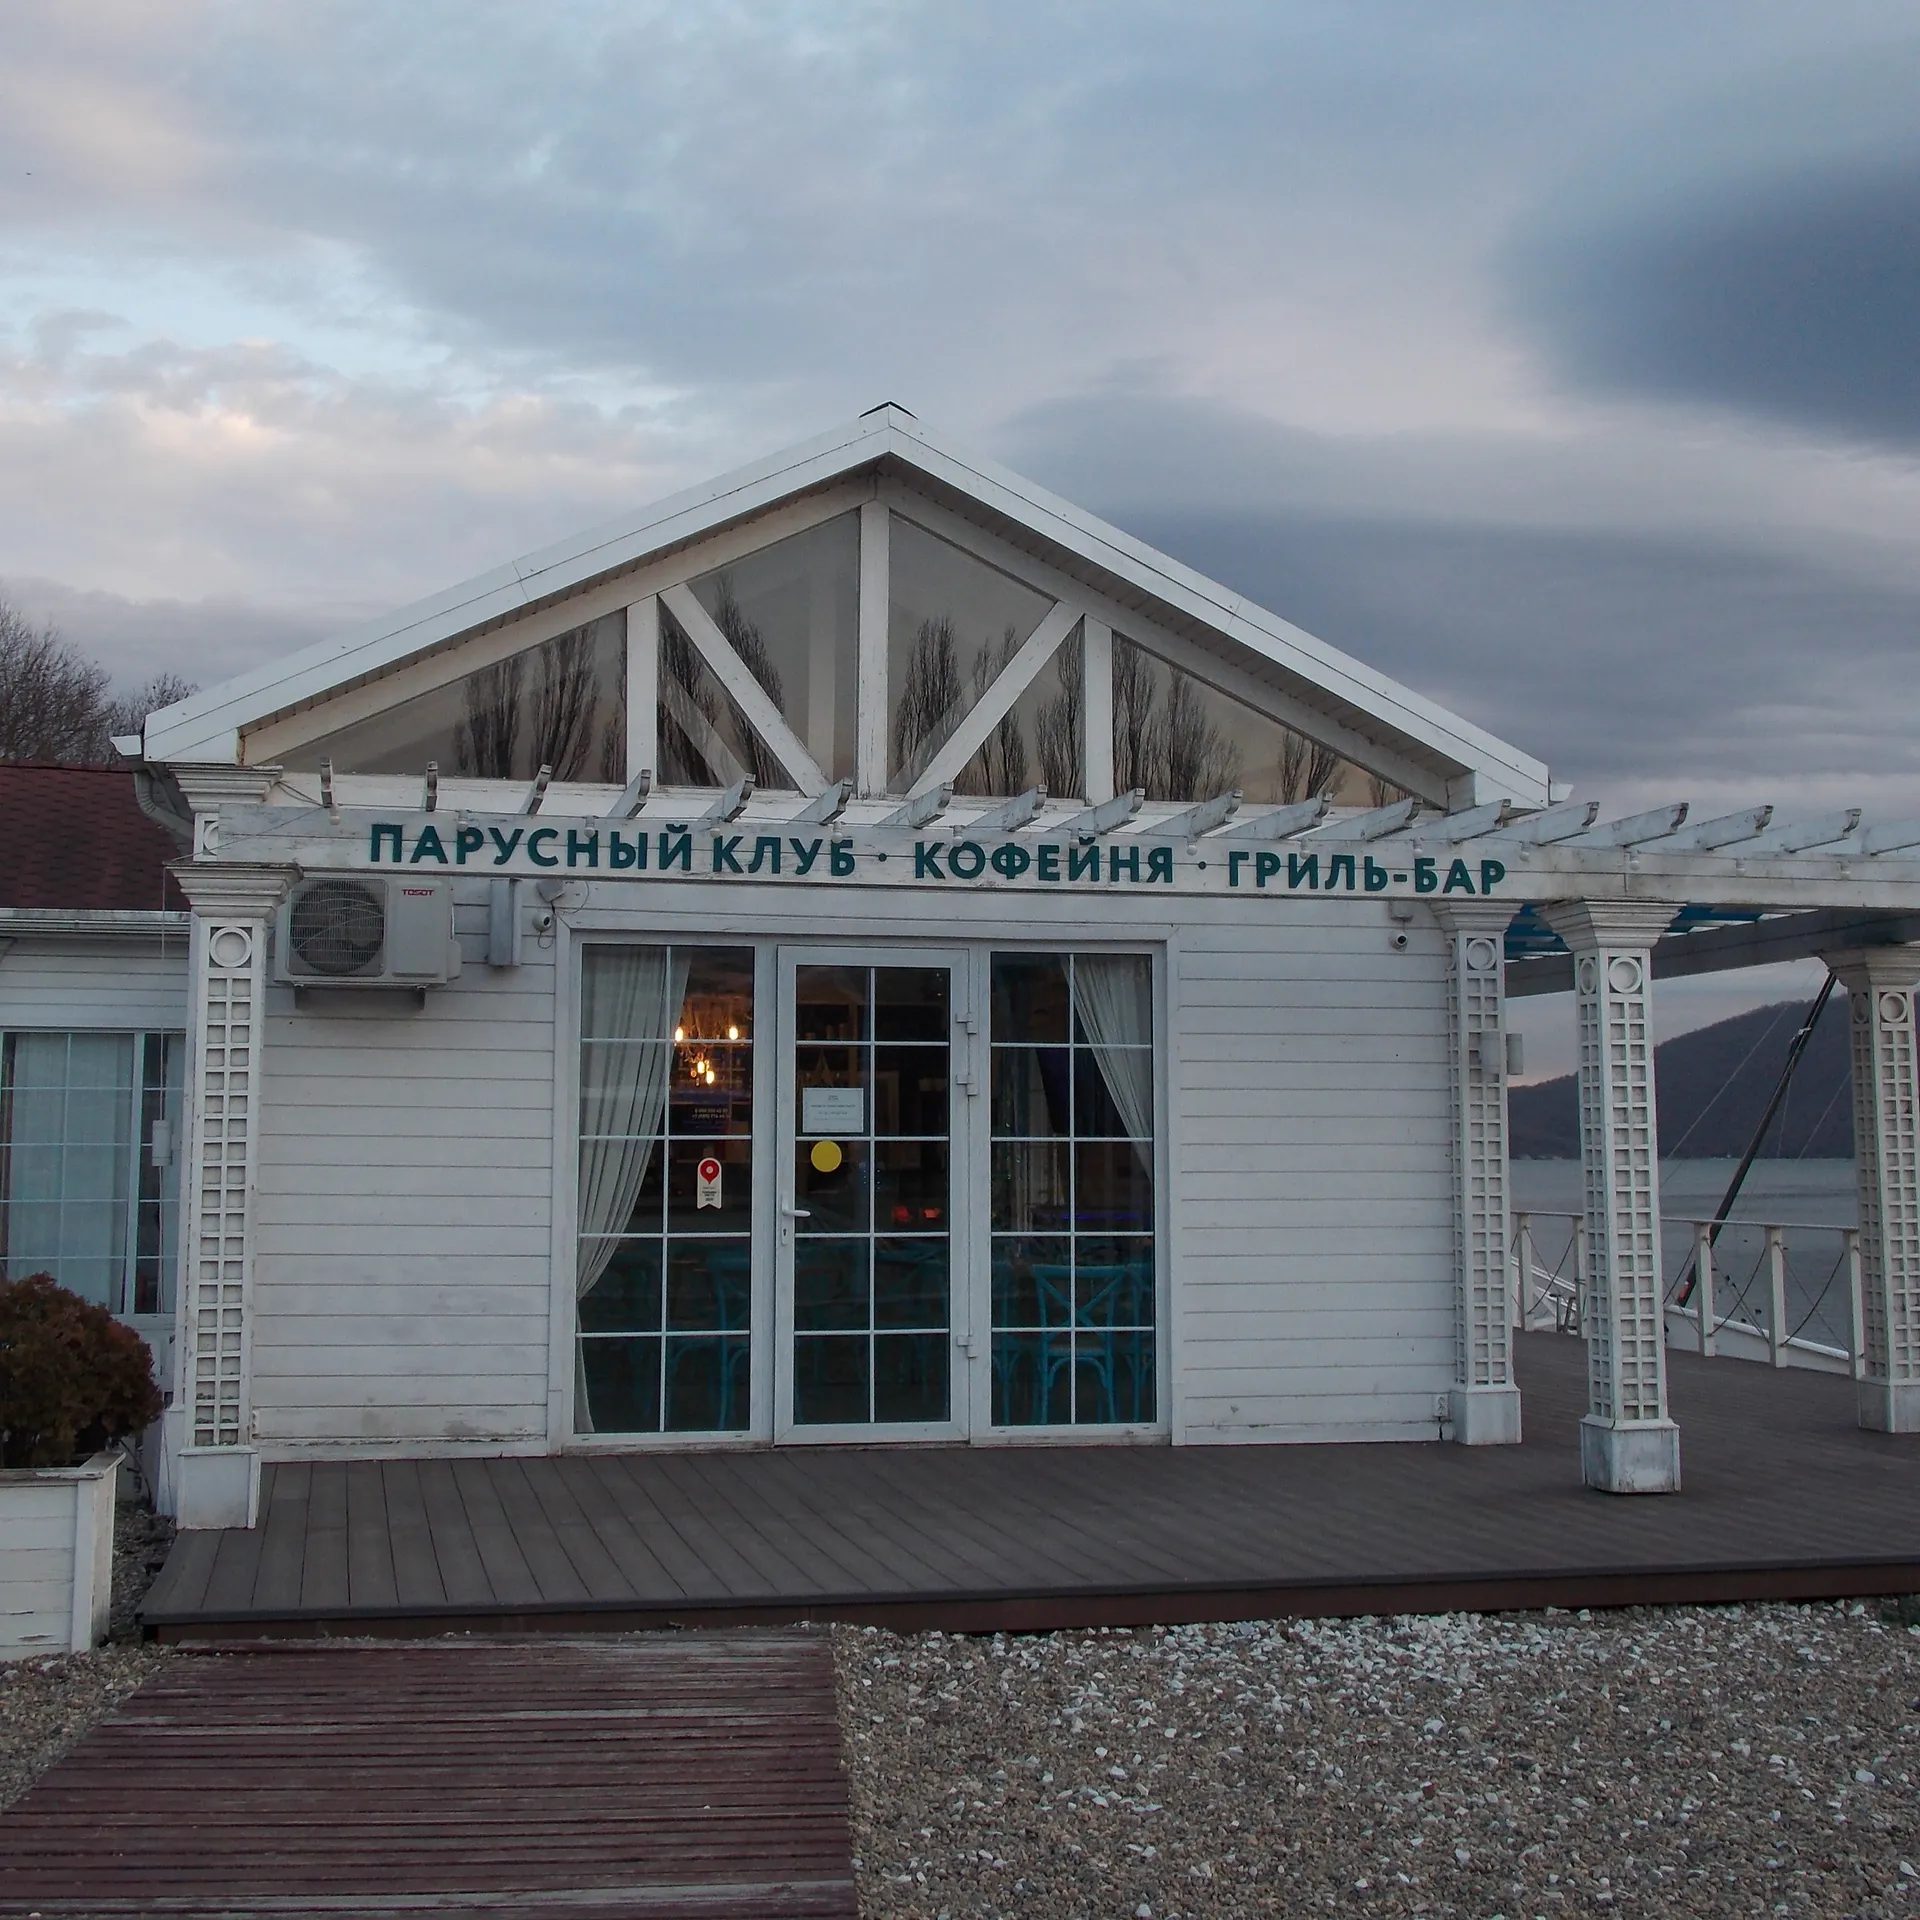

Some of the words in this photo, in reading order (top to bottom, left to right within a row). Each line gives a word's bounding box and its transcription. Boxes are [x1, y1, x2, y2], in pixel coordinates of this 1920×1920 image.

[370, 824, 692, 871] ПАРУСНЫЙ
[712, 836, 856, 877] КЛУБ
[914, 836, 1174, 884] КОФЕЙНЯ
[1229, 852, 1506, 896] ГРИЛЬ-БАР
[401, 888, 435, 896] TOSOT
